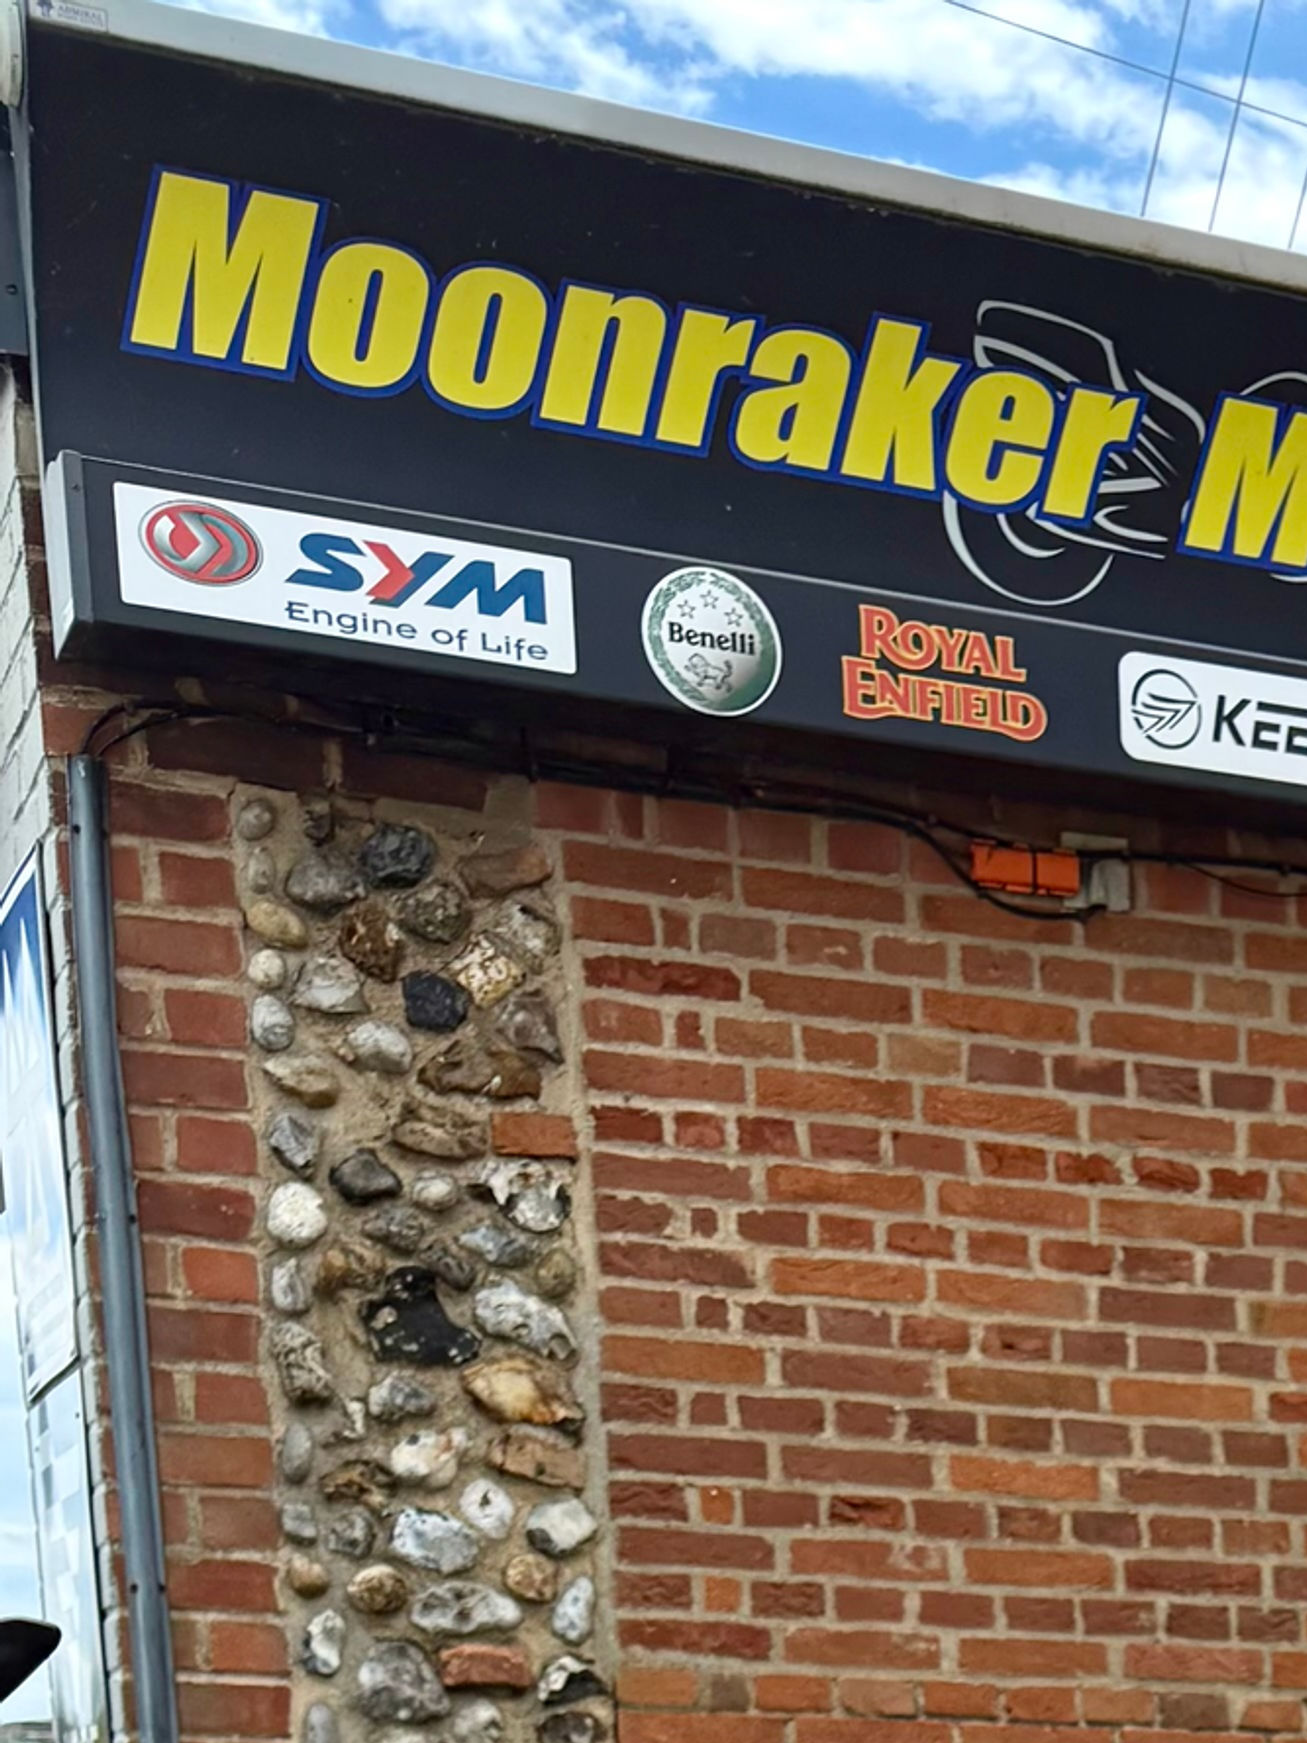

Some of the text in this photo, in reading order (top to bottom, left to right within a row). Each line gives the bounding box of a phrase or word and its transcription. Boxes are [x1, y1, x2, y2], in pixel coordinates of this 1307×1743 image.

[124, 166, 1146, 527] Moonraker
[284, 533, 547, 625] SYM
[285, 600, 548, 662] Engine of Life
[668, 621, 756, 656] Benelli
[858, 604, 1026, 682] ROYAL
[841, 656, 1048, 742] ENFIELD
